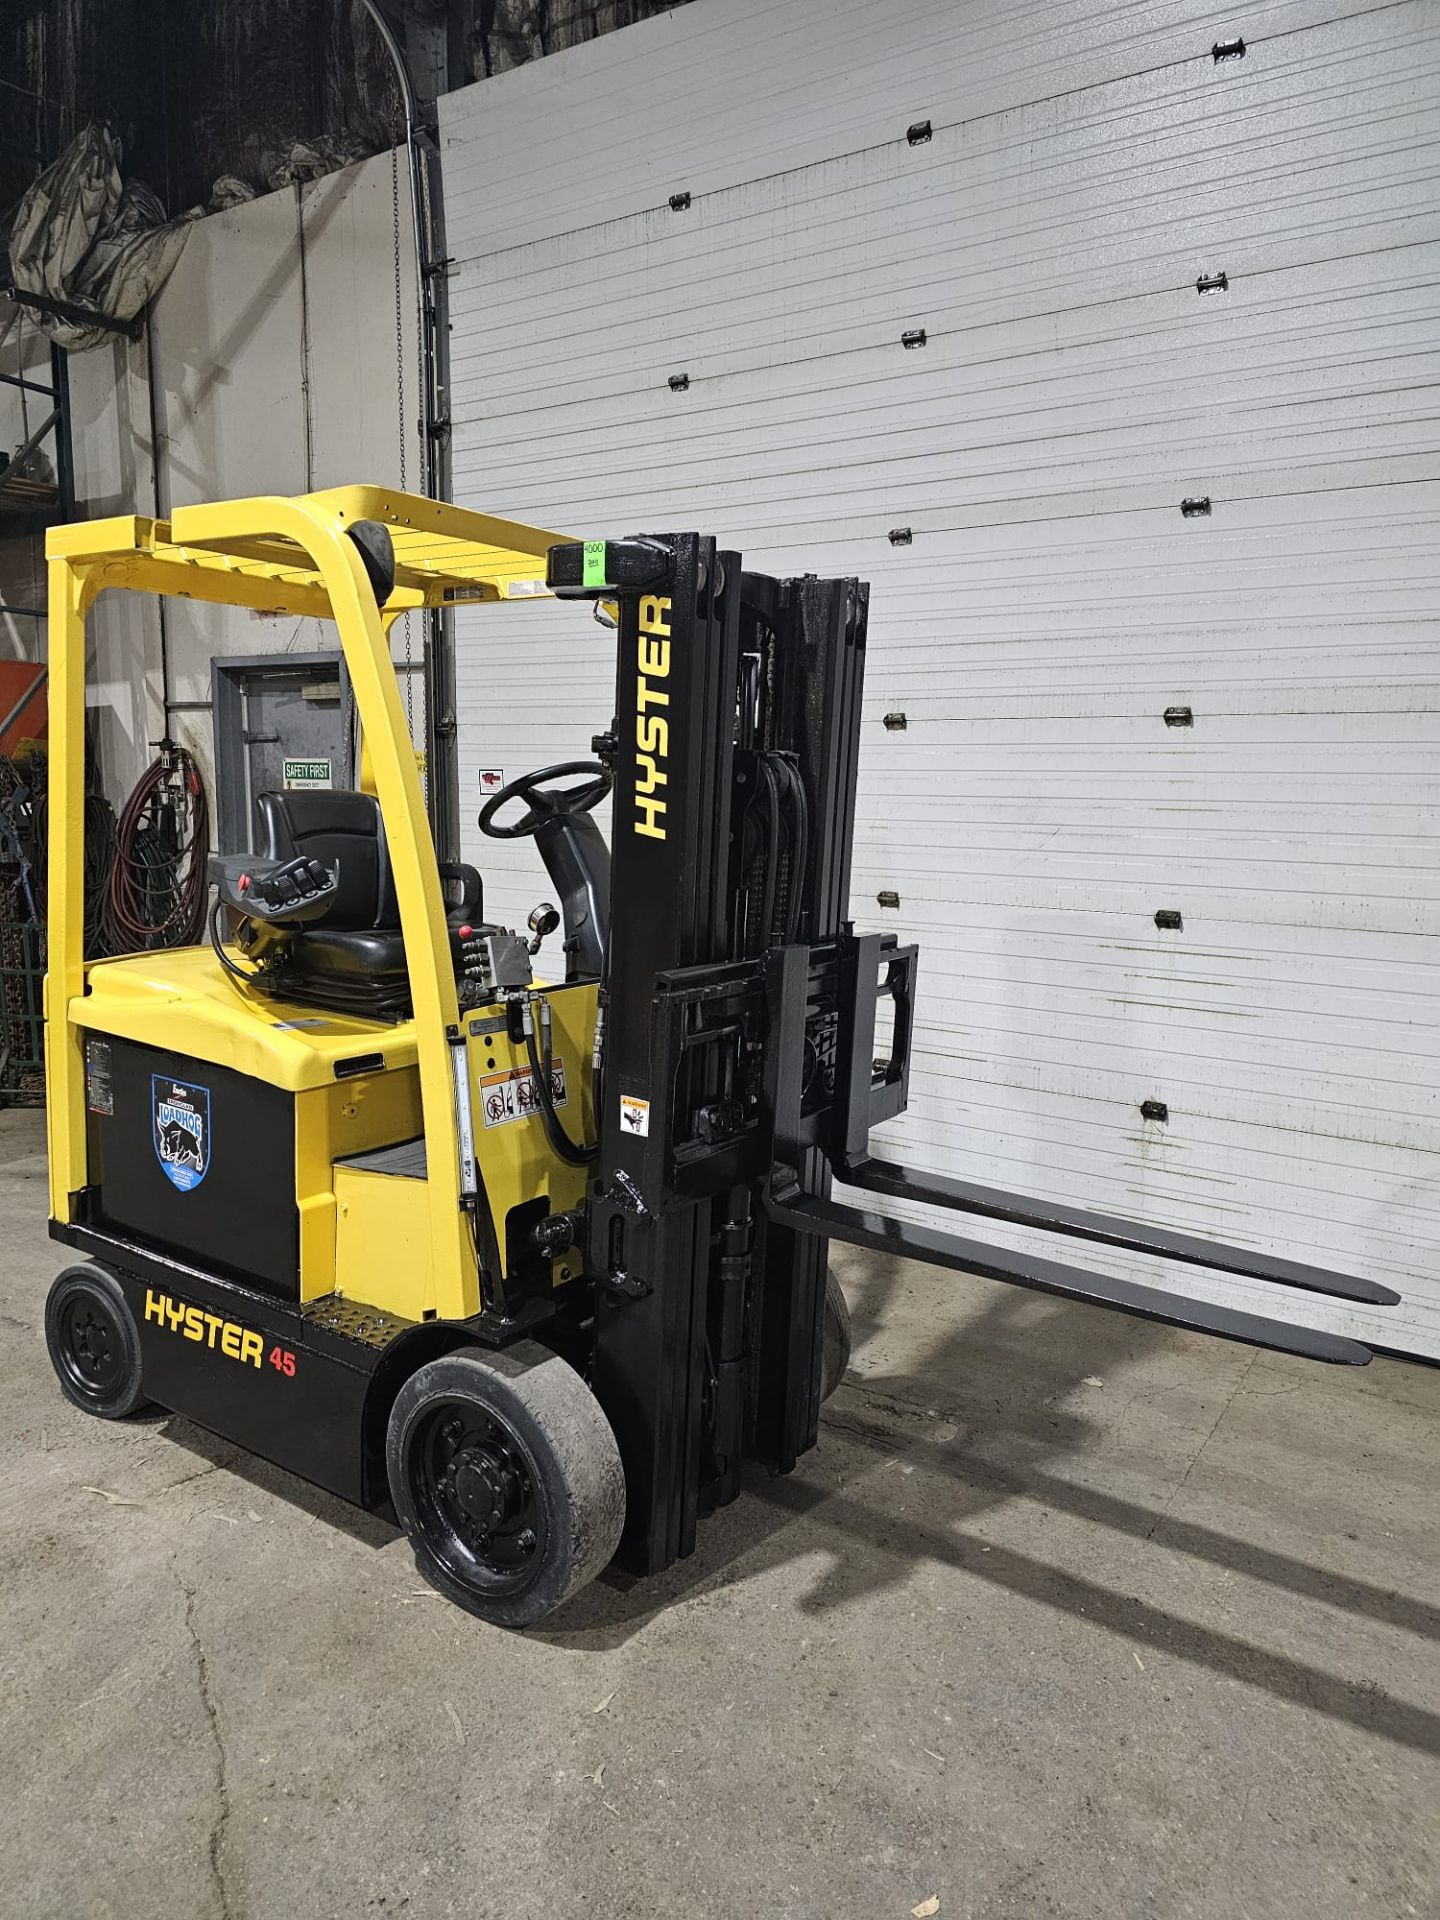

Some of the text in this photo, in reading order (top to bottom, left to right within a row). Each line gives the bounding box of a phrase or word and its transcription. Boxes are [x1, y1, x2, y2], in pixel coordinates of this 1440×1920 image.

[634, 594, 672, 841] HYSTER
[286, 764, 328, 779] SAFETY FIRST
[159, 1103, 202, 1138] LOADHOG
[144, 1289, 296, 1377] HYSTER 45
